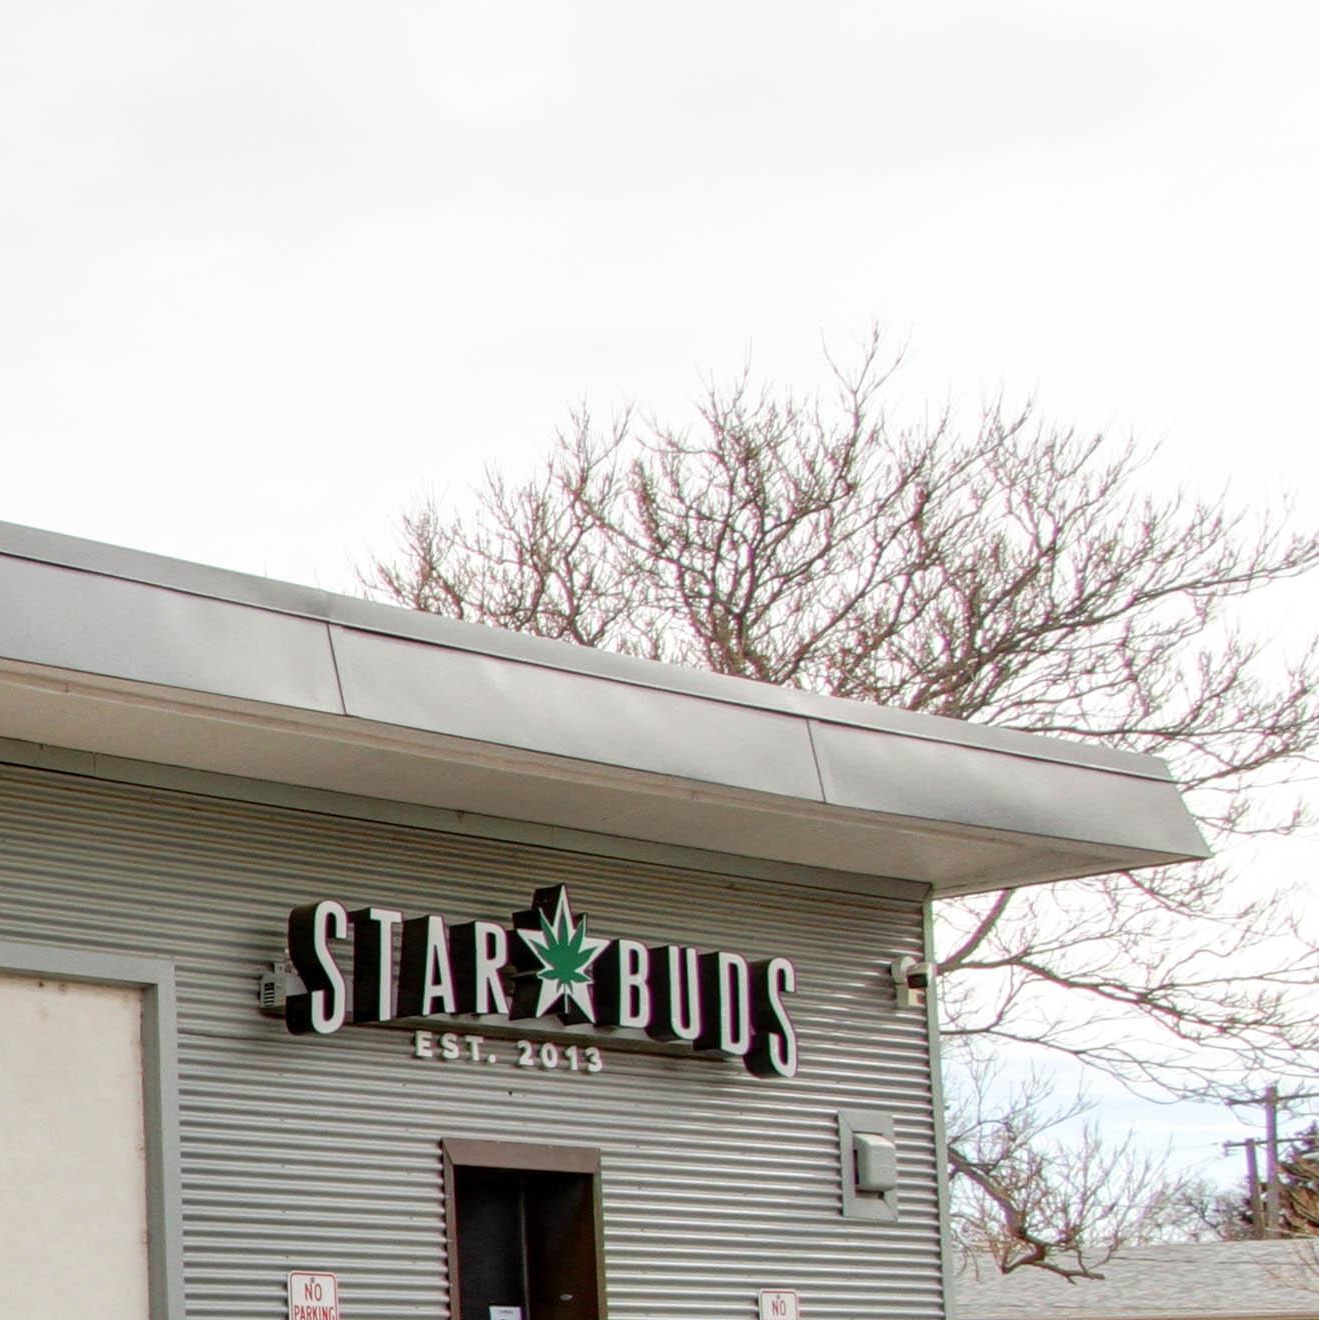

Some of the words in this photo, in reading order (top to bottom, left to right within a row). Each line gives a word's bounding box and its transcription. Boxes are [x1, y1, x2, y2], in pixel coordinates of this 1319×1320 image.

[310, 900, 510, 1035] STAR
[618, 938, 798, 1078] BUDS
[414, 1030, 498, 1065] EST.
[517, 1041, 604, 1074] 2013
[304, 1283, 322, 1302] NO
[772, 1300, 786, 1316] NO
